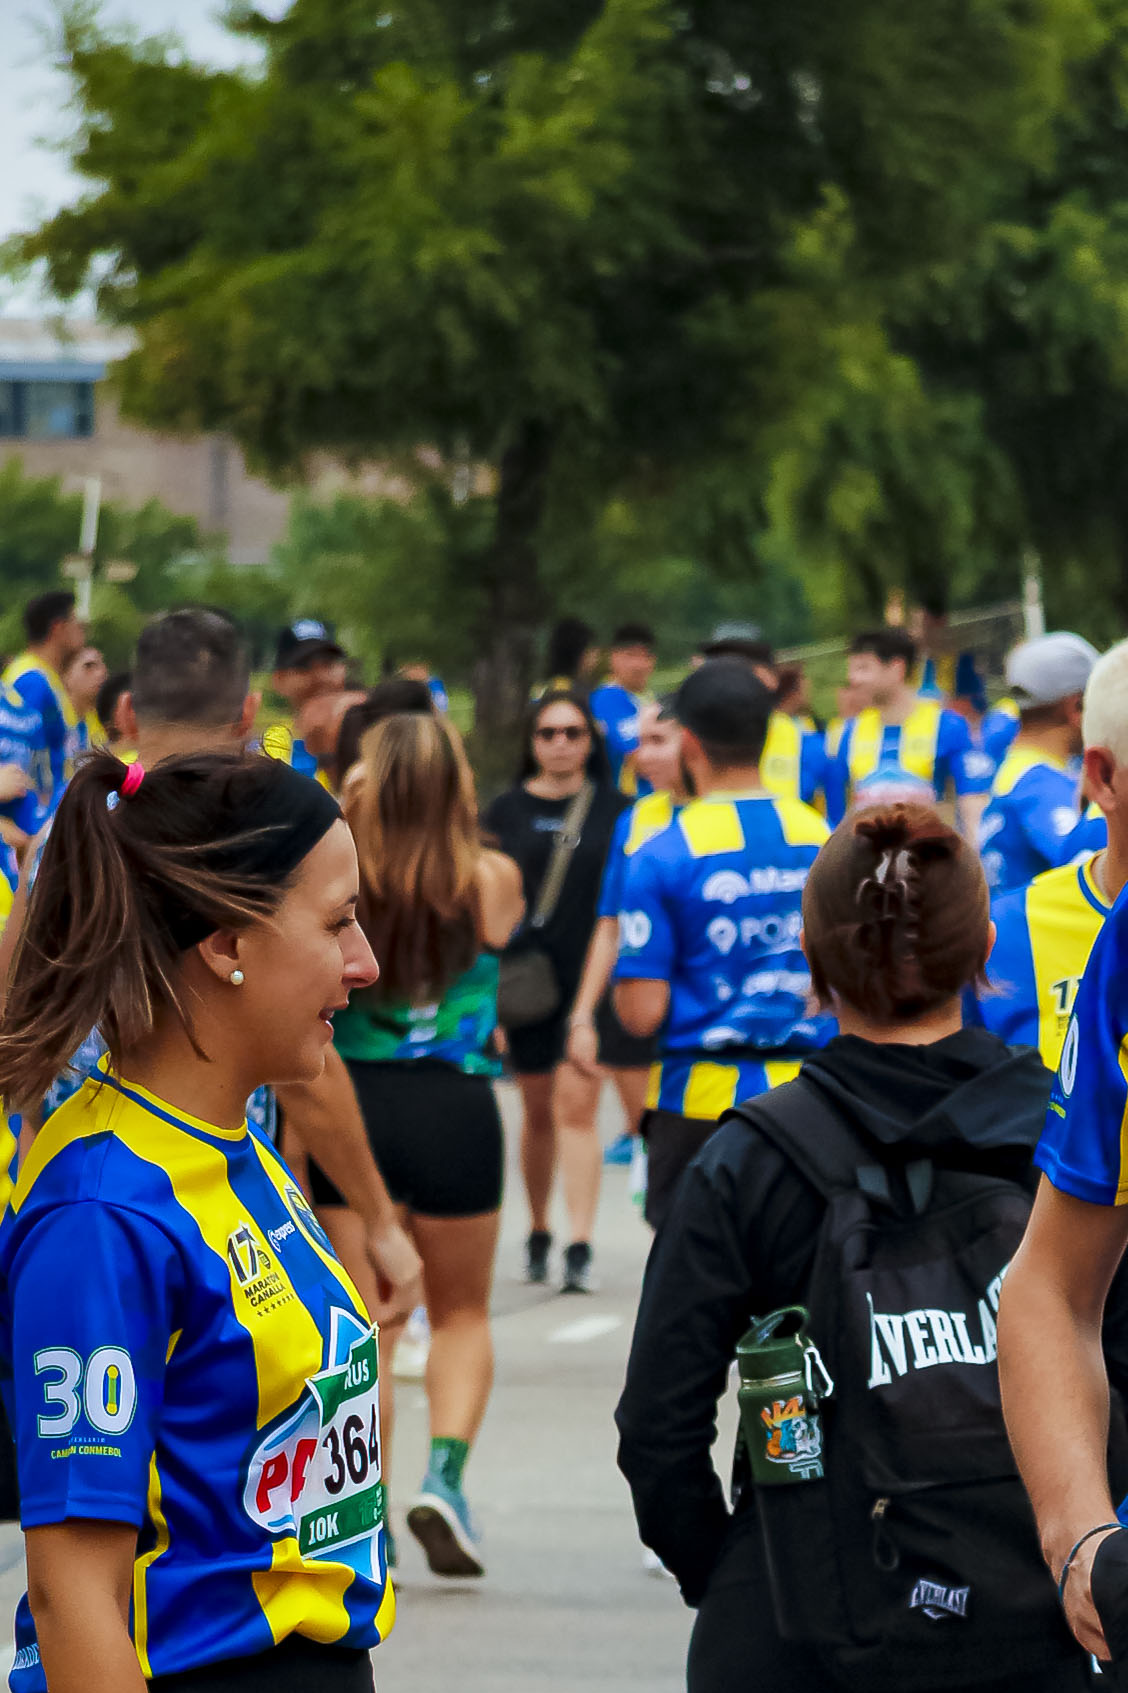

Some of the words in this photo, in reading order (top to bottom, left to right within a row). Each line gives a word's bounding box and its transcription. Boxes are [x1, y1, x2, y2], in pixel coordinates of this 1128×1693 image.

[227, 1221, 262, 1288] 17
[34, 1345, 138, 1438] 30
[322, 1403, 380, 1495] 364
[308, 1511, 340, 1546] 10K
